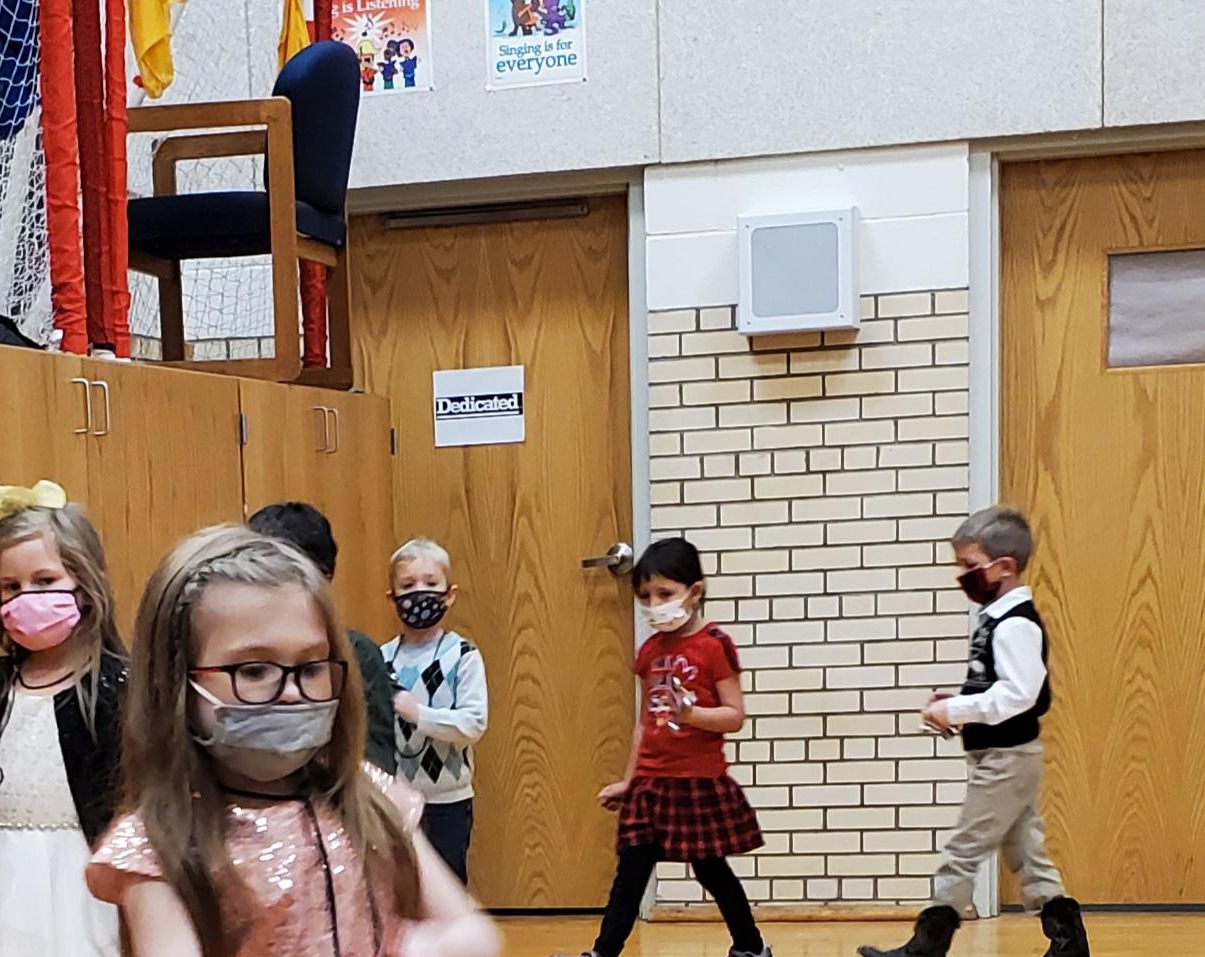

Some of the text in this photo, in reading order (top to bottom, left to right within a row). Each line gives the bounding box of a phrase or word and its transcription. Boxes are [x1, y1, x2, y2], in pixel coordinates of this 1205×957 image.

[342, 2, 353, 13] is
[499, 39, 572, 57] Singing is for
[496, 53, 577, 75] everyone
[436, 394, 519, 413] Dedicated
